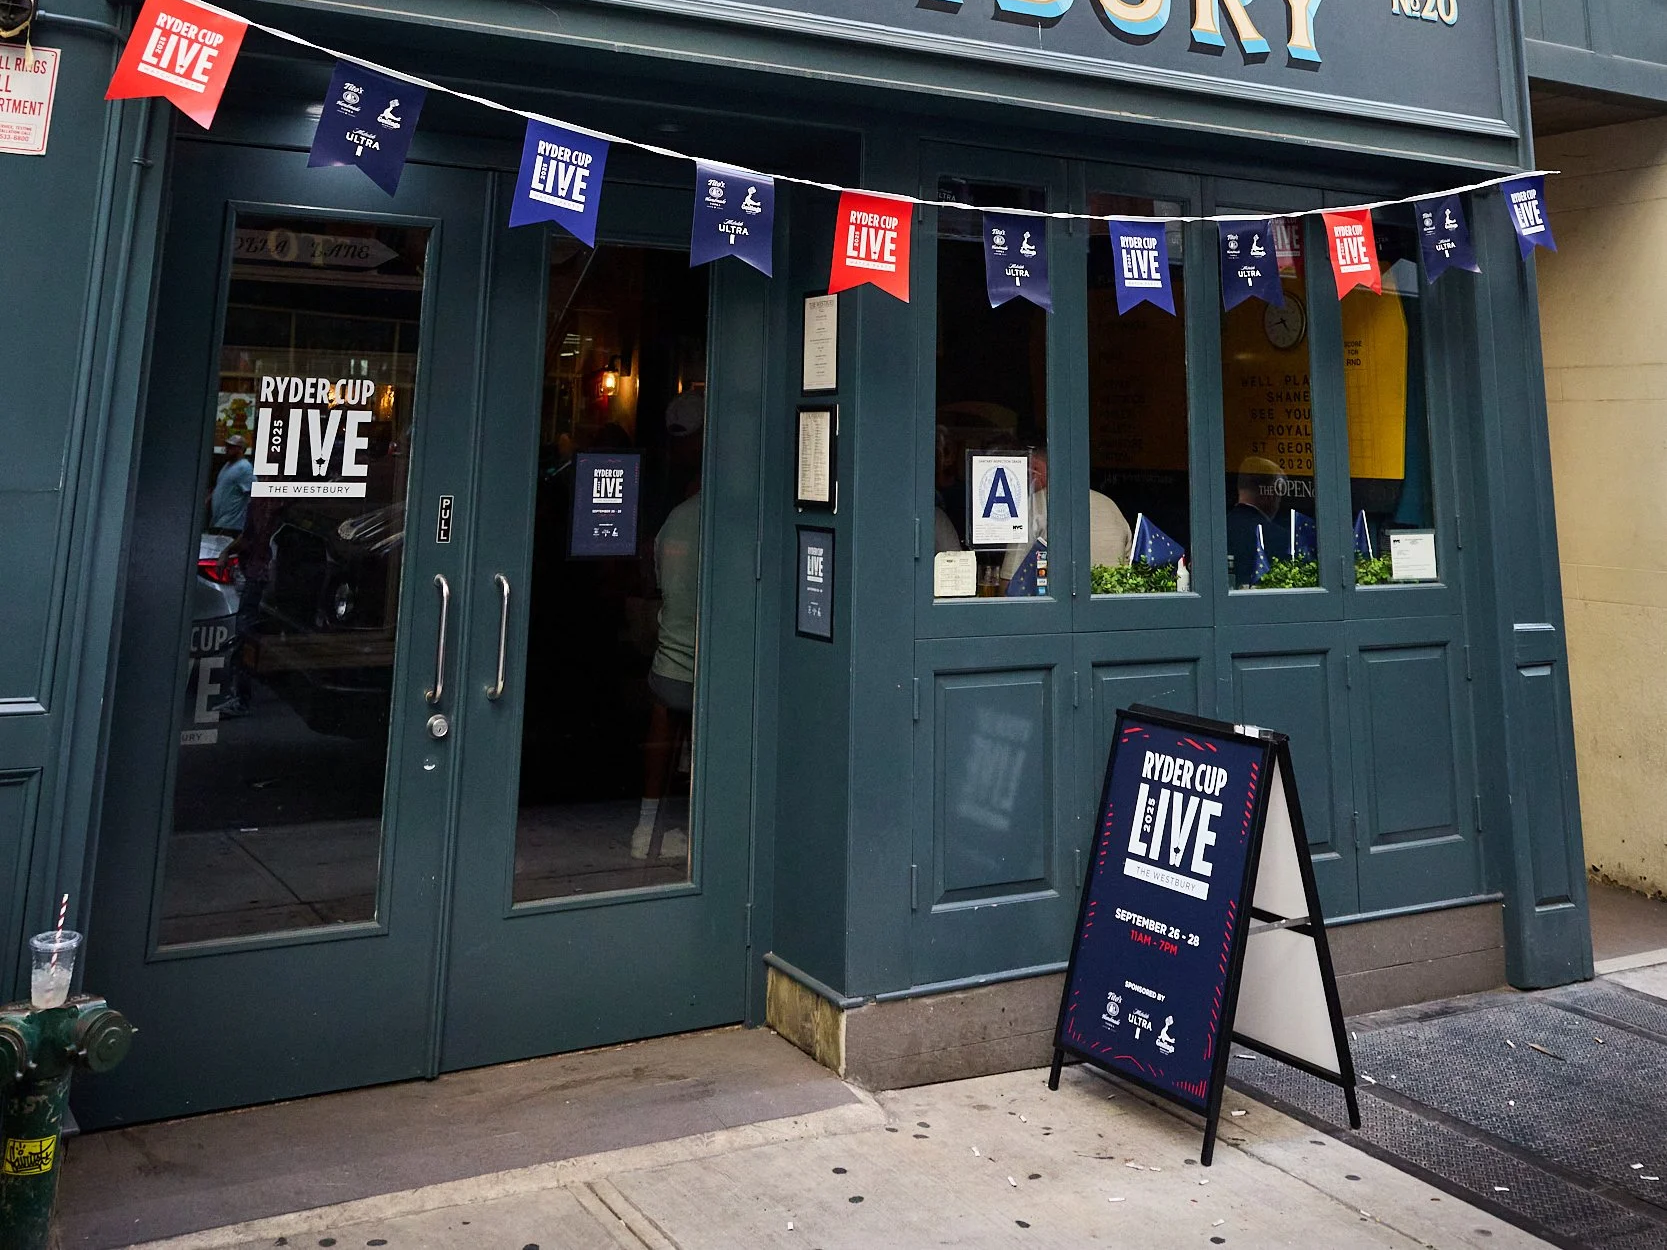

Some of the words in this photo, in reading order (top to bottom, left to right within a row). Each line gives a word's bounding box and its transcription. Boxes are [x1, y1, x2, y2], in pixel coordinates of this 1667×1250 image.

[155, 12, 198, 40] RYDER
[197, 28, 224, 47] CUP
[15, 57, 47, 75] RIGS
[142, 27, 219, 83] LIVE
[346, 132, 380, 151] ULTRA
[538, 140, 571, 162] RYDER
[571, 150, 593, 168] CUP
[531, 154, 590, 203] LIVE
[850, 210, 880, 227] RYDER
[880, 216, 899, 230] CUP
[1514, 199, 1544, 228] LIVE
[719, 224, 749, 236] ULTRA
[1334, 225, 1352, 237] RYDER
[1352, 224, 1363, 235] CUP
[846, 224, 898, 263] LIVE
[1120, 236, 1143, 249] RYDER
[1143, 237, 1157, 249] CUP
[1336, 236, 1370, 265] LIVE
[1436, 242, 1456, 251] ULTRA
[1005, 268, 1030, 278] ULTRA
[1121, 249, 1161, 280] LIVE
[1238, 269, 1262, 278] ULTRA
[260, 376, 330, 404] RYDER
[335, 379, 375, 405] CUP
[1267, 391, 1310, 402] SHANE
[1250, 408, 1274, 420] SEE
[1285, 408, 1311, 420] YOU
[271, 419, 284, 453] 2025
[1268, 425, 1311, 436] ROYAL
[253, 408, 373, 477] LIVE
[1252, 442, 1266, 453] ST
[594, 468, 613, 477] RYDER
[613, 469, 624, 478] CUP
[1279, 459, 1312, 469] 2020
[293, 486, 350, 494] WESTBURY
[593, 478, 623, 497] LIVE
[982, 468, 1019, 518] A
[1259, 485, 1274, 496] THE
[1273, 478, 1312, 498] OPEN
[440, 499, 450, 540] PULL
[807, 555, 823, 577] LIVE
[1142, 750, 1194, 789] RYDER
[1195, 763, 1228, 796] CUP
[1143, 798, 1156, 833] 2025
[1128, 783, 1223, 877] LIVE
[1137, 866, 1150, 876] THE
[1154, 871, 1196, 891] WESTBURY
[1115, 908, 1167, 936] SEPTEMBER
[1168, 927, 1180, 940] 26
[1187, 933, 1200, 947] 28
[1130, 930, 1151, 946] 11AM
[1159, 940, 1178, 956] 7PM
[1125, 980, 1157, 999] SPONSORED
[1157, 993, 1166, 1002] BY
[1128, 1013, 1152, 1031] ULTRA
